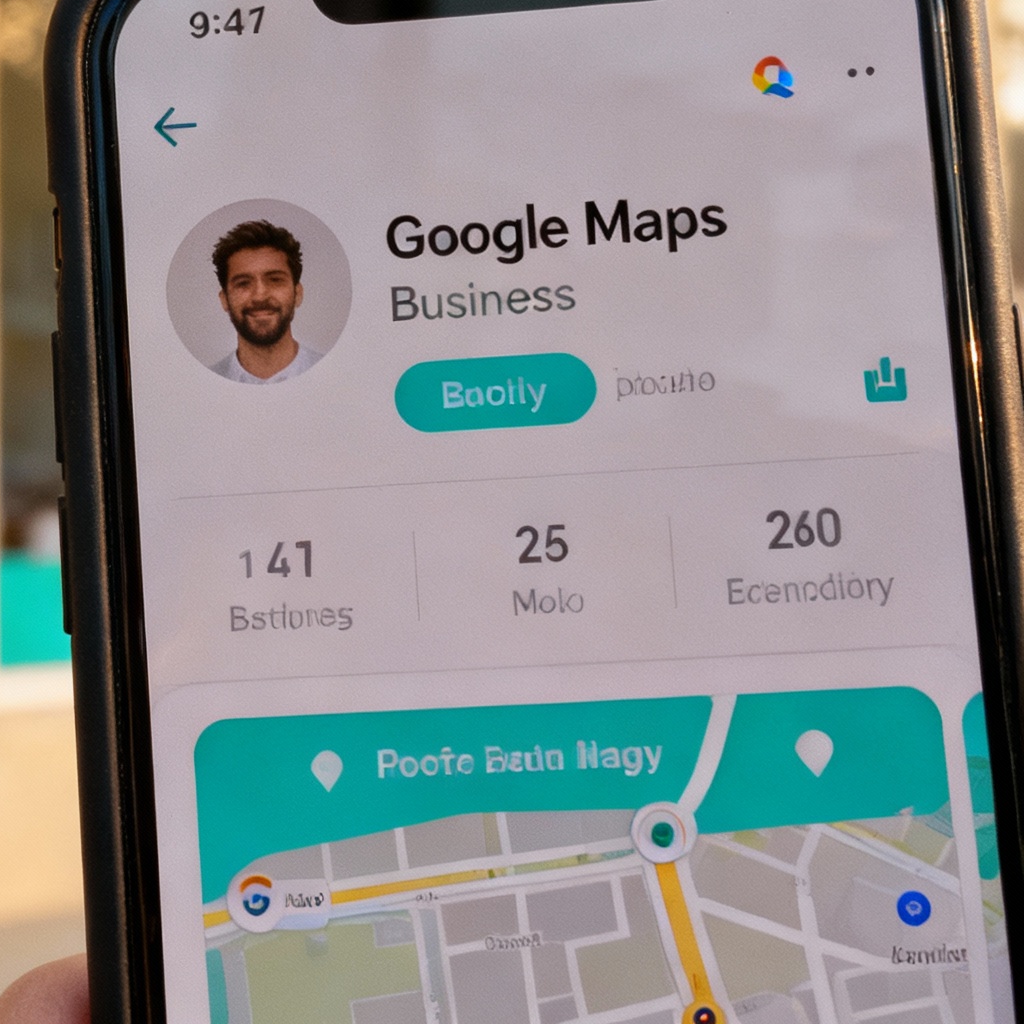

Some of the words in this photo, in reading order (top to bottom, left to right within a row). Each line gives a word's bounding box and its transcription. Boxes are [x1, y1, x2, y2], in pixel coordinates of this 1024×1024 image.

[189, 6, 265, 39] 9:47
[386, 203, 569, 264] Google
[584, 199, 728, 253] Maps
[391, 282, 576, 322] Business
[515, 524, 569, 563] 25
[766, 507, 842, 549] 260
